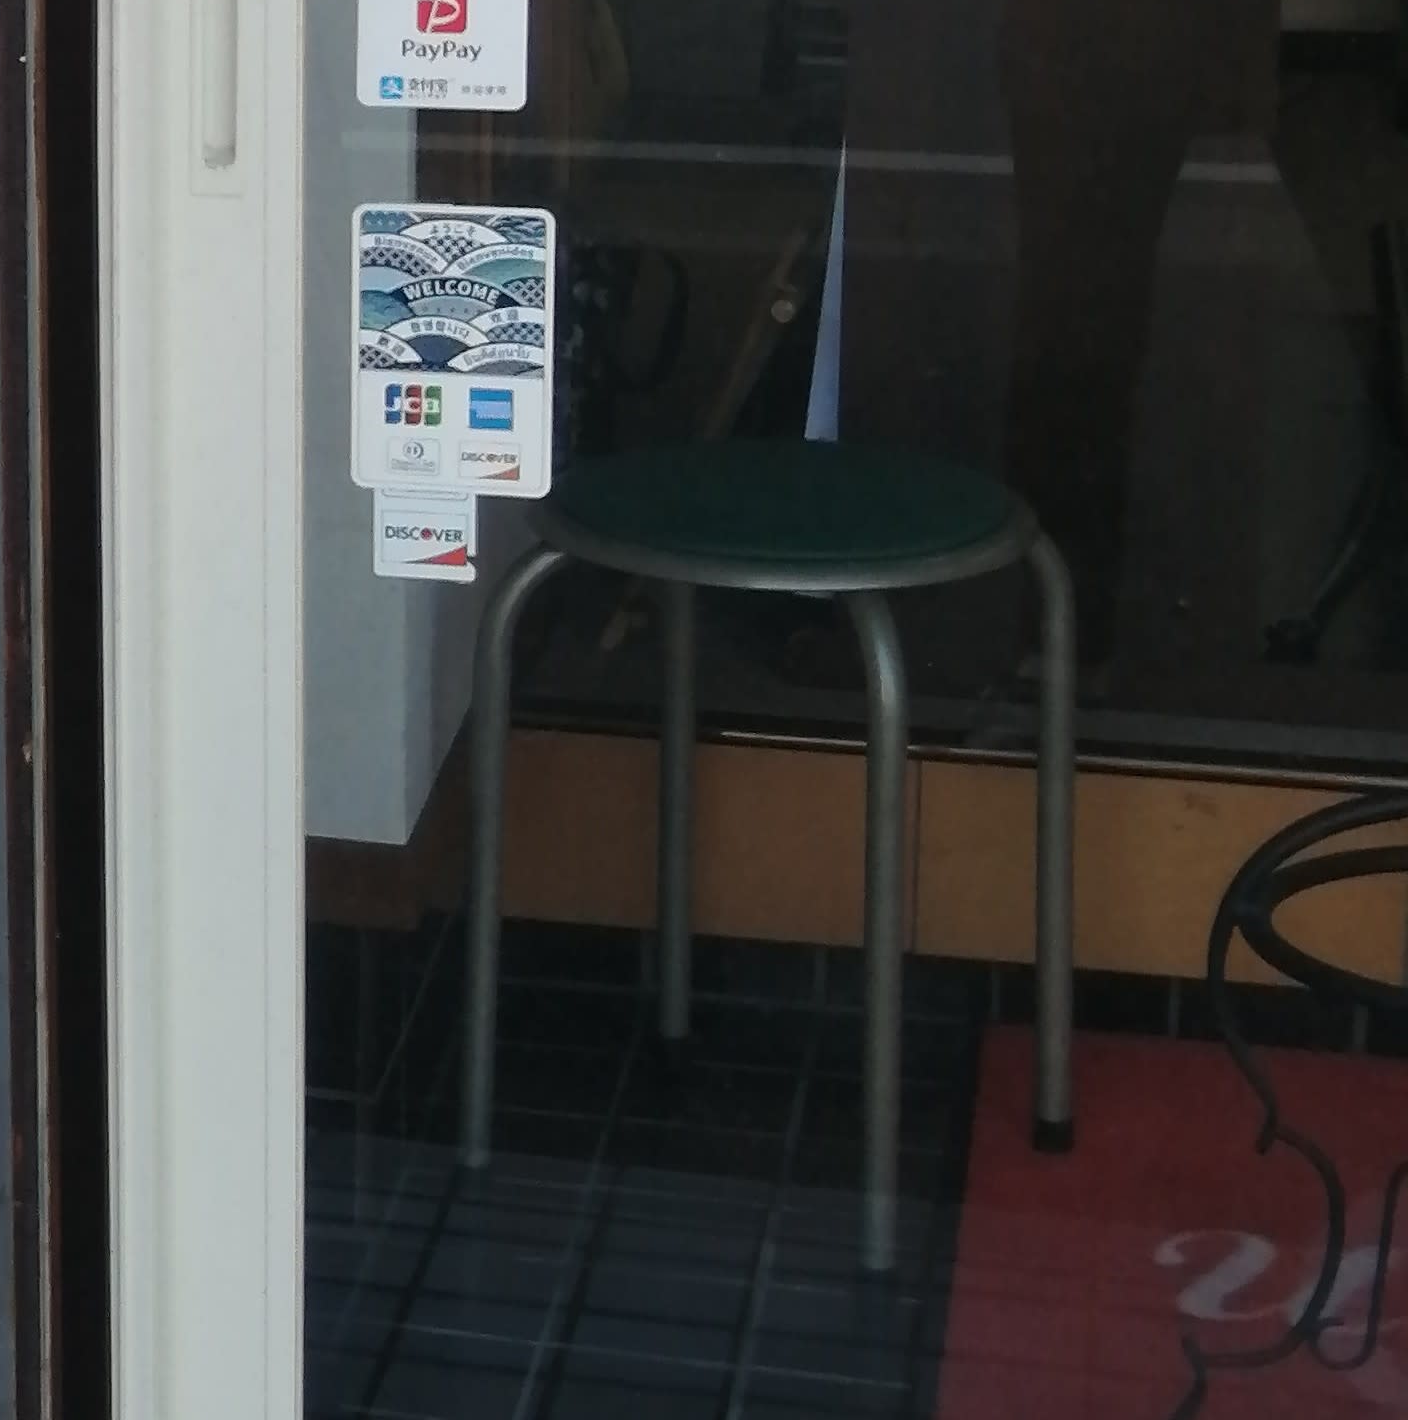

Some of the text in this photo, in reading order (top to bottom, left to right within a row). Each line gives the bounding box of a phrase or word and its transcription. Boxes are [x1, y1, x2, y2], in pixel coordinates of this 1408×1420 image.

[401, 39, 482, 62] PayPay
[403, 279, 501, 309] WELCOME
[384, 526, 464, 542] DISCOVER
